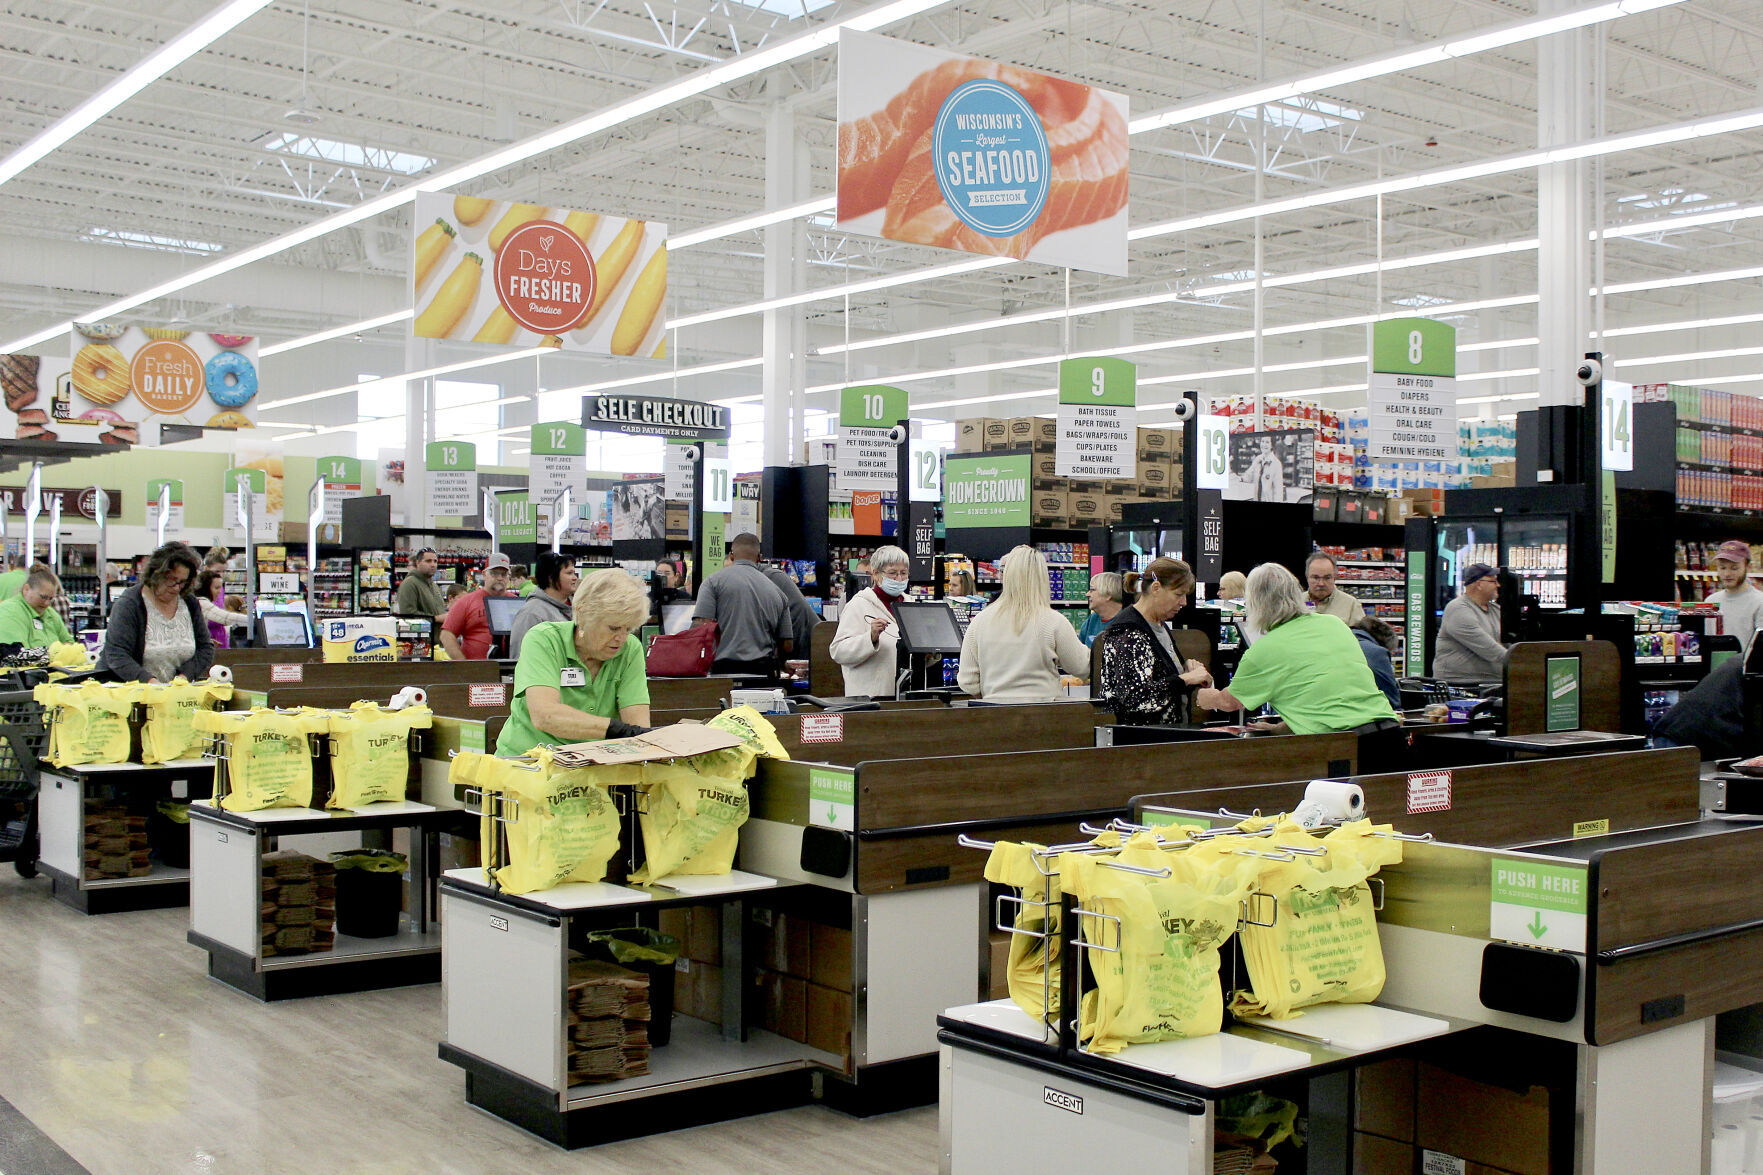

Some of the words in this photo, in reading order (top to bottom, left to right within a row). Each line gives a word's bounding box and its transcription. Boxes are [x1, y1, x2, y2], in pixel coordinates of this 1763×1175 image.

[956, 113, 1022, 130] WISCONSIN'S
[975, 132, 1007, 148] Largest
[947, 149, 1039, 186] SEAFOOD
[974, 193, 1021, 204] SELECTION
[518, 249, 572, 280] Days
[510, 275, 581, 304] FRESHER
[529, 302, 562, 316] Produce
[1408, 330, 1423, 365] 8
[144, 357, 193, 376] Fresh
[143, 374, 194, 396] DAILY
[1091, 367, 1105, 396] 9
[1397, 377, 1415, 387] BABY
[1415, 378, 1434, 388] FOOD
[1400, 391, 1429, 402] DIAPERS
[597, 397, 637, 421] SELF
[641, 400, 723, 428] CHECKOUT
[863, 394, 884, 420] 10
[1078, 407, 1094, 416] BATH
[1095, 408, 1117, 417] TISSUE
[1385, 405, 1411, 415] HEALTH
[1411, 406, 1417, 415] &
[1418, 406, 1443, 416] BEAUTY
[1074, 419, 1095, 428] PAPER
[1096, 420, 1121, 429] TOWELS
[1396, 419, 1414, 429] ORAL
[1415, 420, 1433, 429] CARE
[1605, 397, 1630, 453] 14
[549, 428, 567, 449] 12
[620, 425, 641, 434] CARD
[642, 426, 680, 437] PAYMENTS
[680, 429, 699, 438] ONLY
[861, 430, 890, 438] FOOD/TRE
[1066, 431, 1128, 441] BAGS/WRAPS/FOILS
[1392, 432, 1436, 443] COUGH/COLD
[846, 439, 857, 447] PET
[1076, 443, 1118, 452] CUPS/PLATES
[442, 446, 458, 466] 13
[859, 450, 887, 458] CLEANING
[1080, 454, 1114, 464] BAKEWARE
[1202, 429, 1226, 475] 13
[1382, 446, 1416, 457] FEMININE
[1417, 447, 1445, 458] HYGIENE
[331, 462, 346, 479] 14
[843, 470, 869, 478] LAUNDRY
[914, 451, 937, 490] 12
[975, 466, 998, 478] Proudly
[1071, 466, 1121, 475] SCHOOL/OFFICE
[710, 468, 727, 502] 11
[948, 478, 1026, 504] HOMEGROWN
[499, 500, 531, 526] LOCAL
[915, 528, 933, 542] SELF
[1203, 521, 1221, 536] SELF
[710, 535, 720, 547] WE
[916, 541, 931, 555] BAG
[1204, 536, 1220, 552] BAG
[708, 546, 722, 558] BAG
[270, 580, 289, 590] WINE
[1411, 593, 1422, 612] GAS
[331, 629, 345, 637] 48
[1411, 614, 1422, 662] REWARDS
[346, 652, 395, 662] essentials
[177, 700, 201, 708] TURK
[368, 734, 404, 748] TUREY
[812, 776, 832, 788] PUSH
[833, 779, 852, 792] HERE
[698, 788, 742, 807] TURKE
[1577, 821, 1599, 831] WARNING
[1497, 869, 1537, 889] PUSH
[1542, 875, 1580, 895] HERE
[1046, 1091, 1082, 1111] ACCENT
